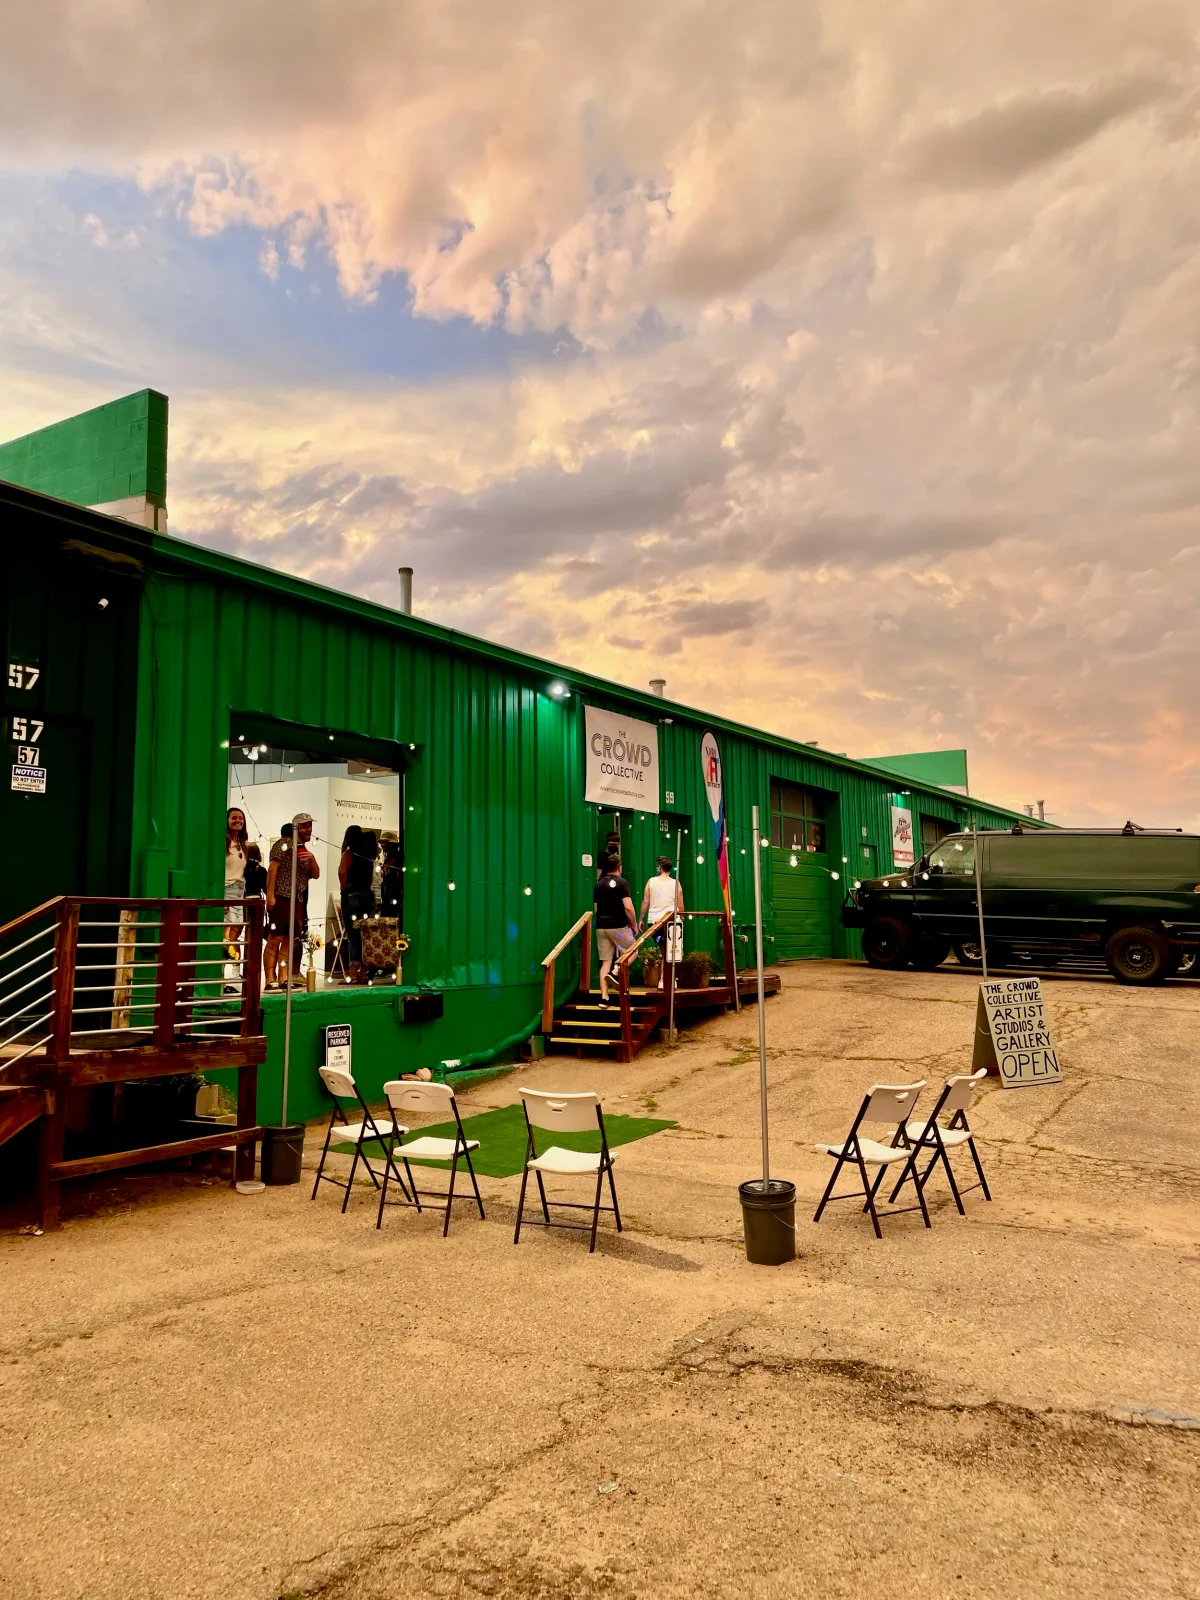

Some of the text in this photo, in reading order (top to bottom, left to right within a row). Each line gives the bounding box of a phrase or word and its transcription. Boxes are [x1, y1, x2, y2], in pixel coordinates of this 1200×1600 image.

[8, 664, 40, 690] 57
[12, 717, 44, 743] 57
[618, 730, 627, 739] THE
[19, 747, 38, 765] 57
[590, 733, 652, 768] CROWD
[15, 768, 43, 777] NOTICE
[600, 763, 644, 782] COLLECTIVE
[984, 980, 1039, 995] THE CROWD
[986, 991, 1042, 1005] COLLECTIVE
[992, 1004, 1044, 1022] ARTIST
[328, 1030, 349, 1038] RESERVED
[994, 1020, 1046, 1035] STUDIOS &
[996, 1032, 1051, 1051] GALLERY
[1001, 1050, 1060, 1079] OPEN
